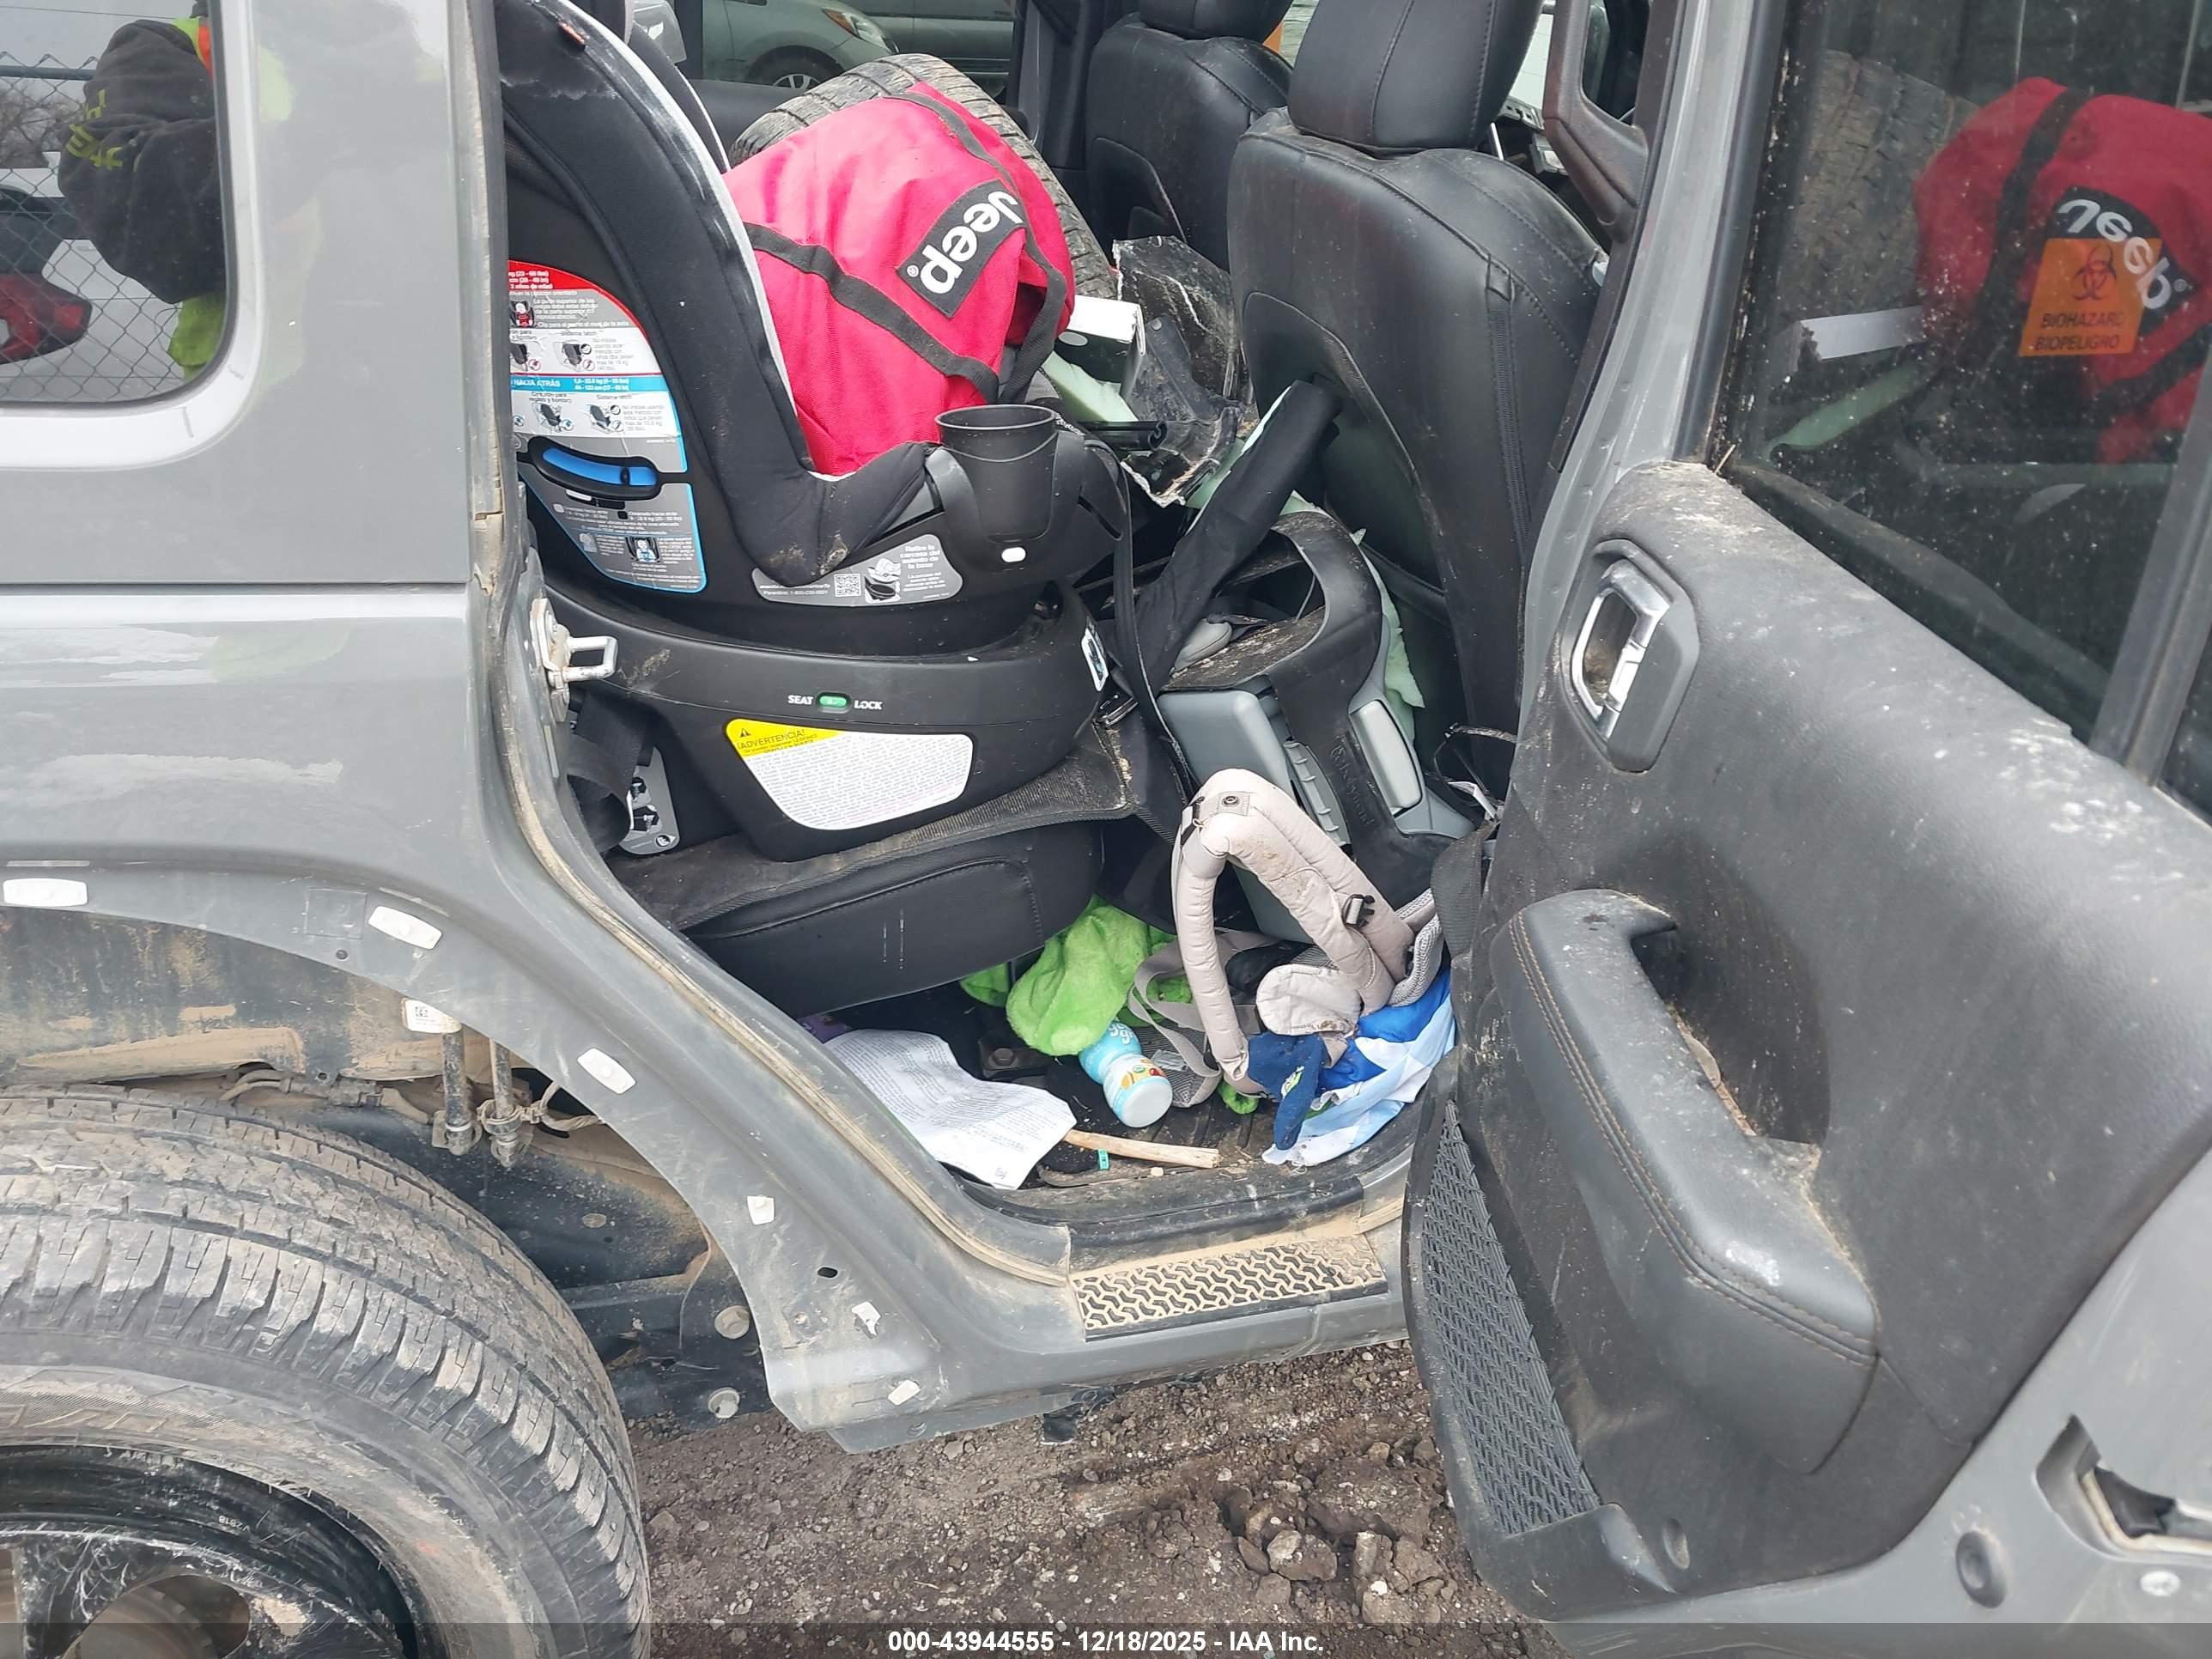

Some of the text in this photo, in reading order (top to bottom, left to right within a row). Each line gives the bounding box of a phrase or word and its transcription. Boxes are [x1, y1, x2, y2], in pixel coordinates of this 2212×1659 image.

[921, 191, 1023, 295] Jeep
[2034, 335, 2120, 351] BIOPELIGRO
[787, 695, 813, 705] SEAT
[854, 700, 883, 710] LOCK
